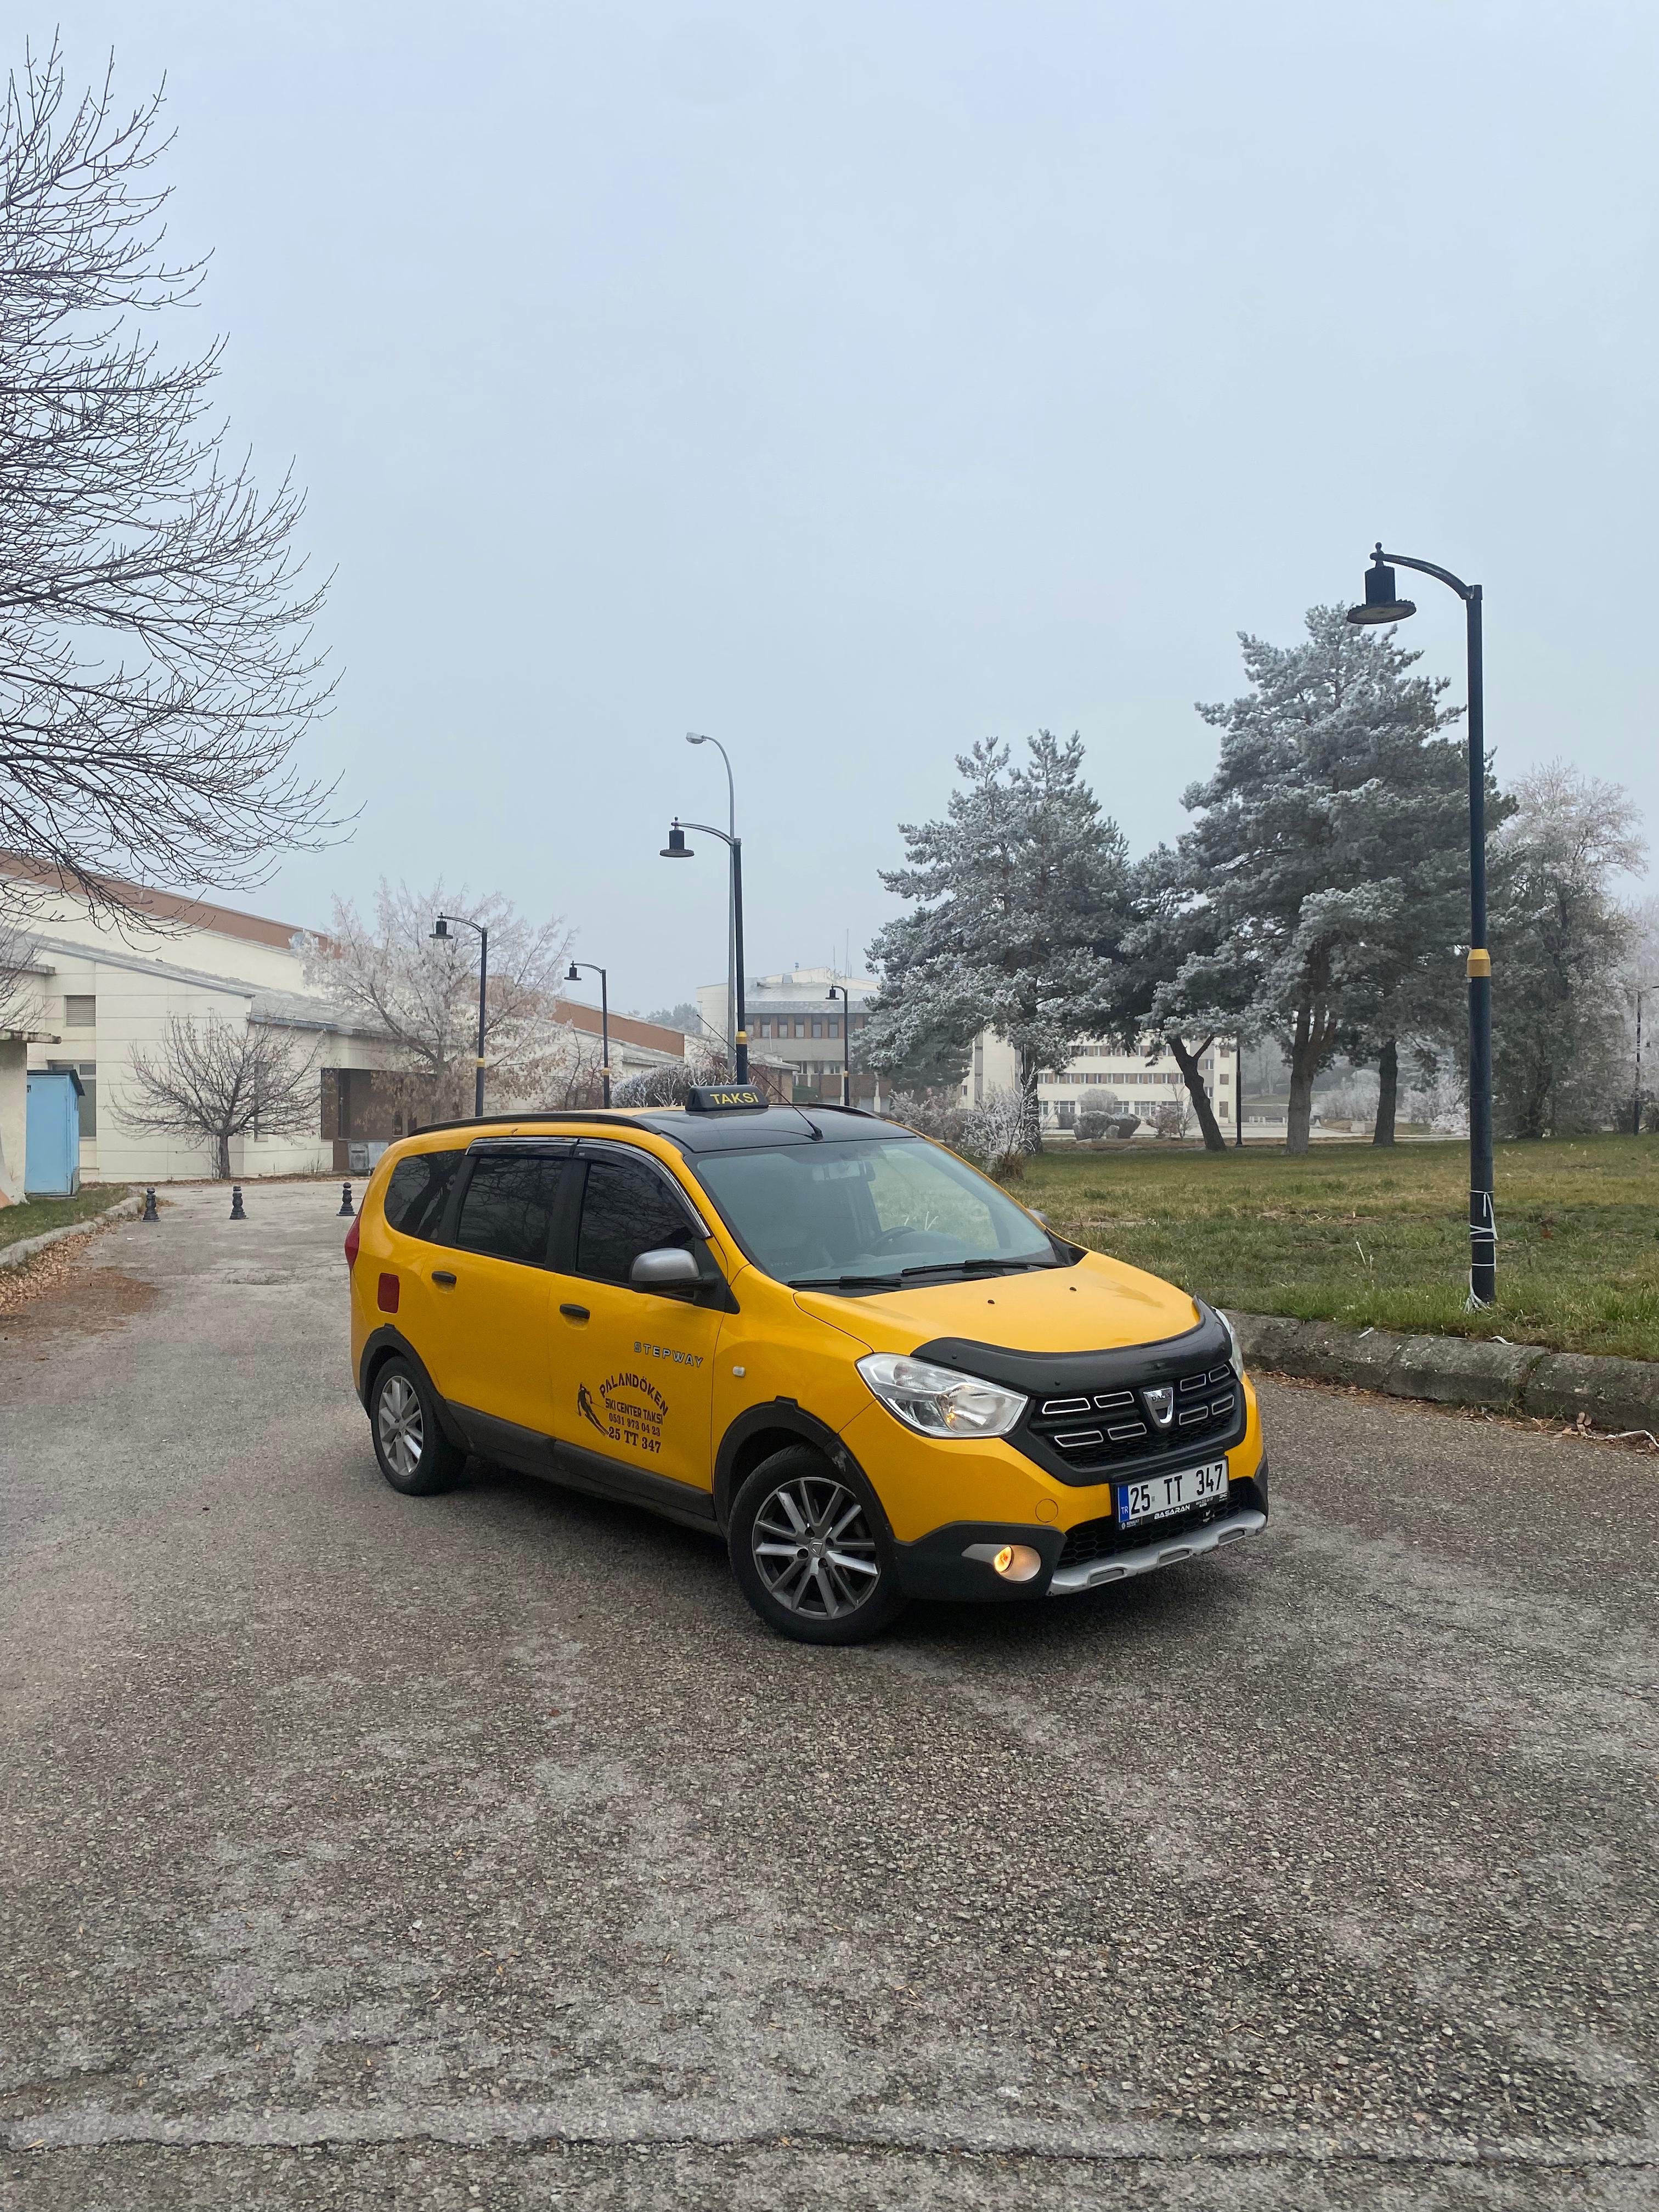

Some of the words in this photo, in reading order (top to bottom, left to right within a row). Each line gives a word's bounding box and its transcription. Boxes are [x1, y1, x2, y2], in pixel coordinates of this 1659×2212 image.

[634, 1341, 703, 1368] STEPWAY
[599, 1373, 668, 1417] PALANDÖKEN
[605, 1398, 616, 1410] SKI
[617, 1401, 641, 1418] CENTER
[609, 1413, 624, 1426] 0531
[641, 1423, 650, 1434] 04
[652, 1426, 660, 1436] 23
[609, 1426, 620, 1441] 25
[624, 1430, 639, 1446] TT
[642, 1437, 661, 1453] 347
[1130, 1485, 1150, 1515] 25
[1164, 1475, 1183, 1505] TT
[1195, 1463, 1223, 1496] 347
[1121, 1505, 1128, 1514] TR
